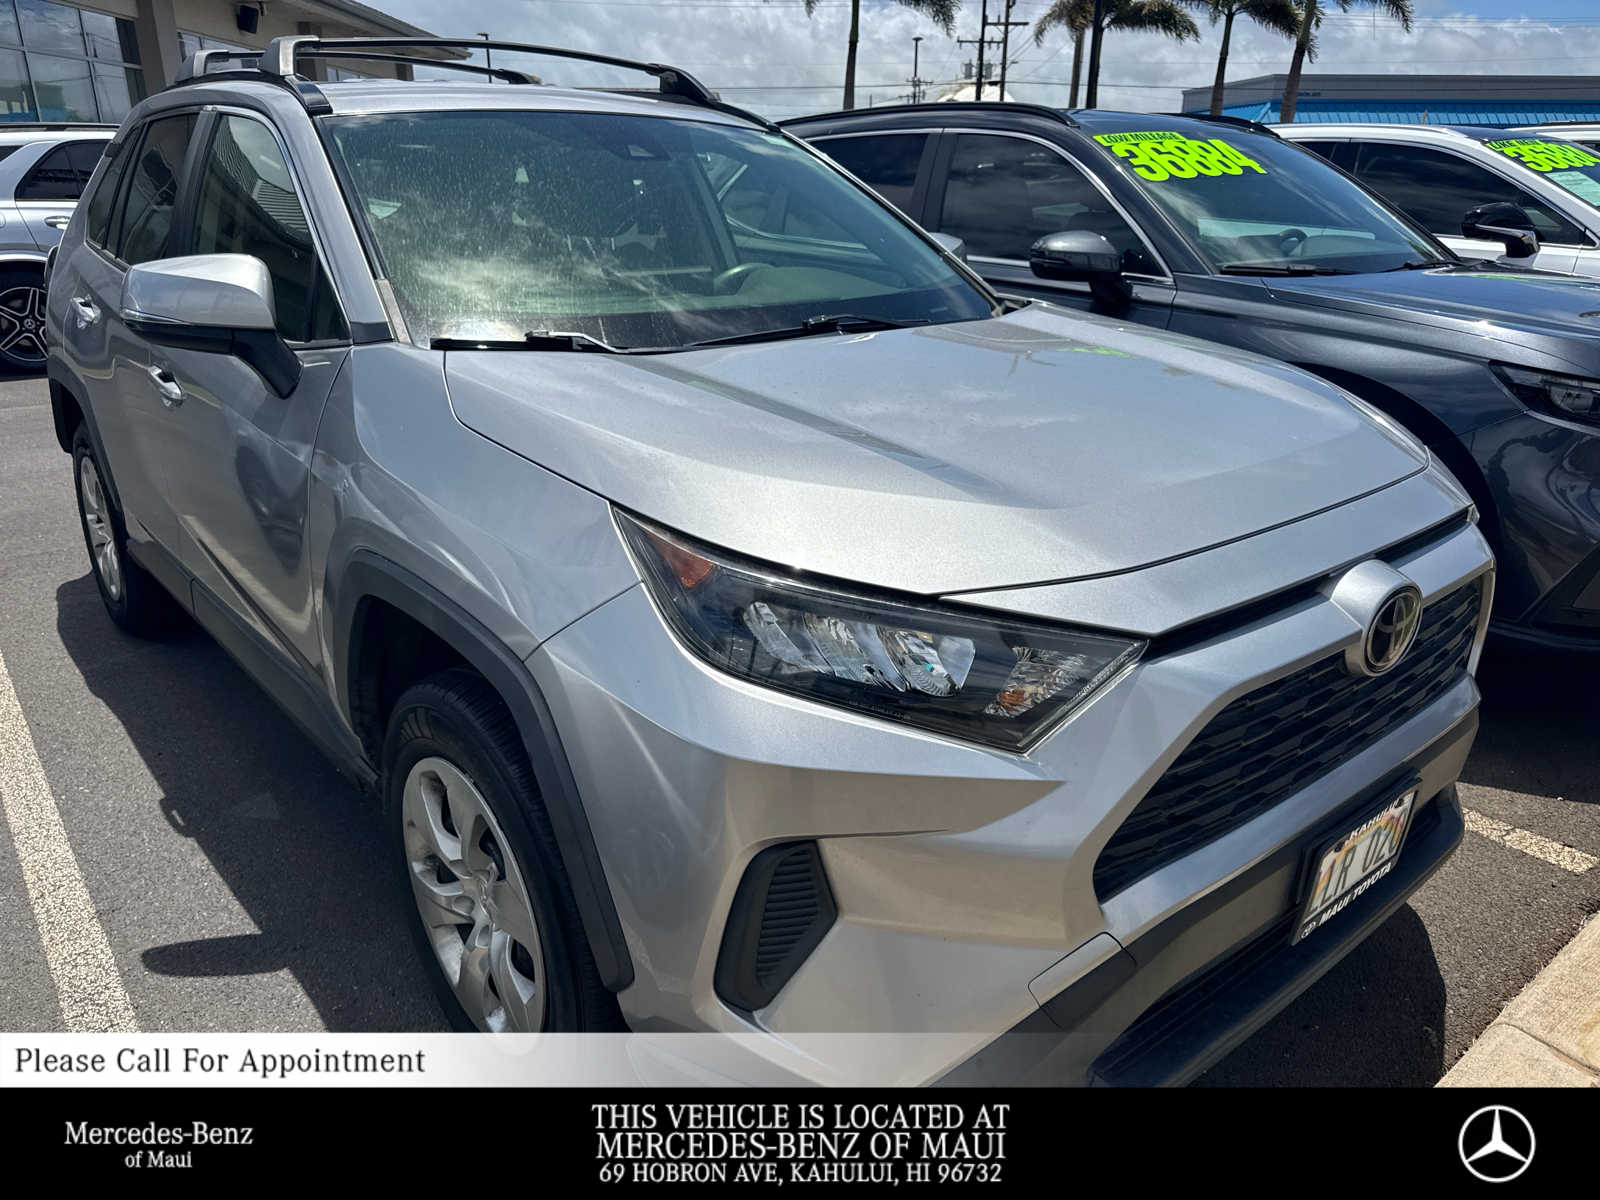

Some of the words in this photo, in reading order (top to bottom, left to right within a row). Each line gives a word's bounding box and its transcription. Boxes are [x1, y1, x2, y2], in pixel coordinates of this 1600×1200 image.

[1101, 133, 1129, 144] LOW
[1129, 131, 1180, 142] MILEAGE
[1111, 139, 1268, 182] 36884
[1319, 892, 1351, 925] MAUI
[1352, 861, 1392, 901] TOYOTA
